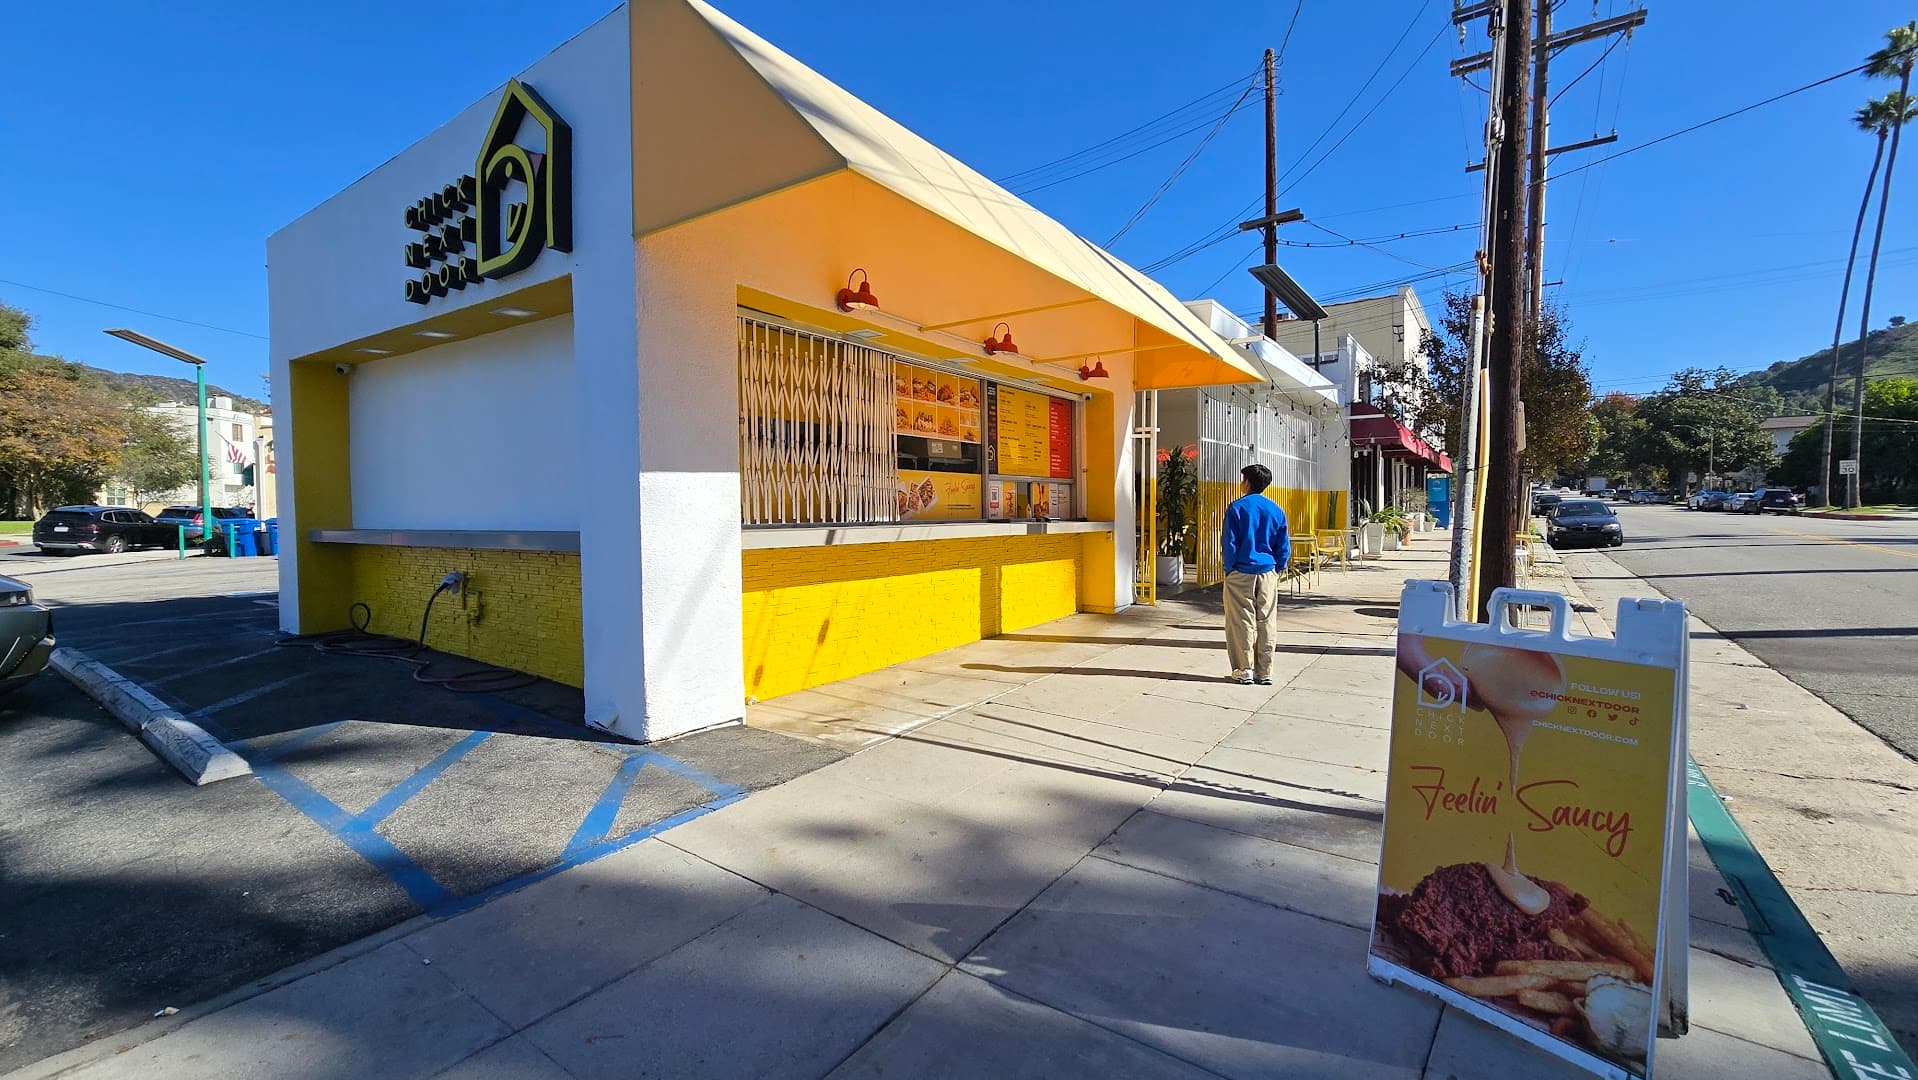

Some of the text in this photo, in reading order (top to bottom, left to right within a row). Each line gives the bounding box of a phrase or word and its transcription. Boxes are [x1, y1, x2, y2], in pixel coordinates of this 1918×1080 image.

[404, 175, 470, 231] CHICK
[404, 216, 470, 268] NEXT
[405, 257, 470, 303] DOOR
[1529, 690, 1641, 714] @CHICKNEXTDOOR
[1571, 682, 1641, 700] FOLLOW US!
[1415, 718, 1465, 735] NEXT
[1416, 708, 1465, 725] CHICK
[1415, 729, 1464, 745] DOOR
[1531, 719, 1639, 746] CHICKNEXTDOOR.COM
[1410, 765, 1634, 858] Feelin' Saucy
[1792, 974, 1892, 1052] LIMIT
